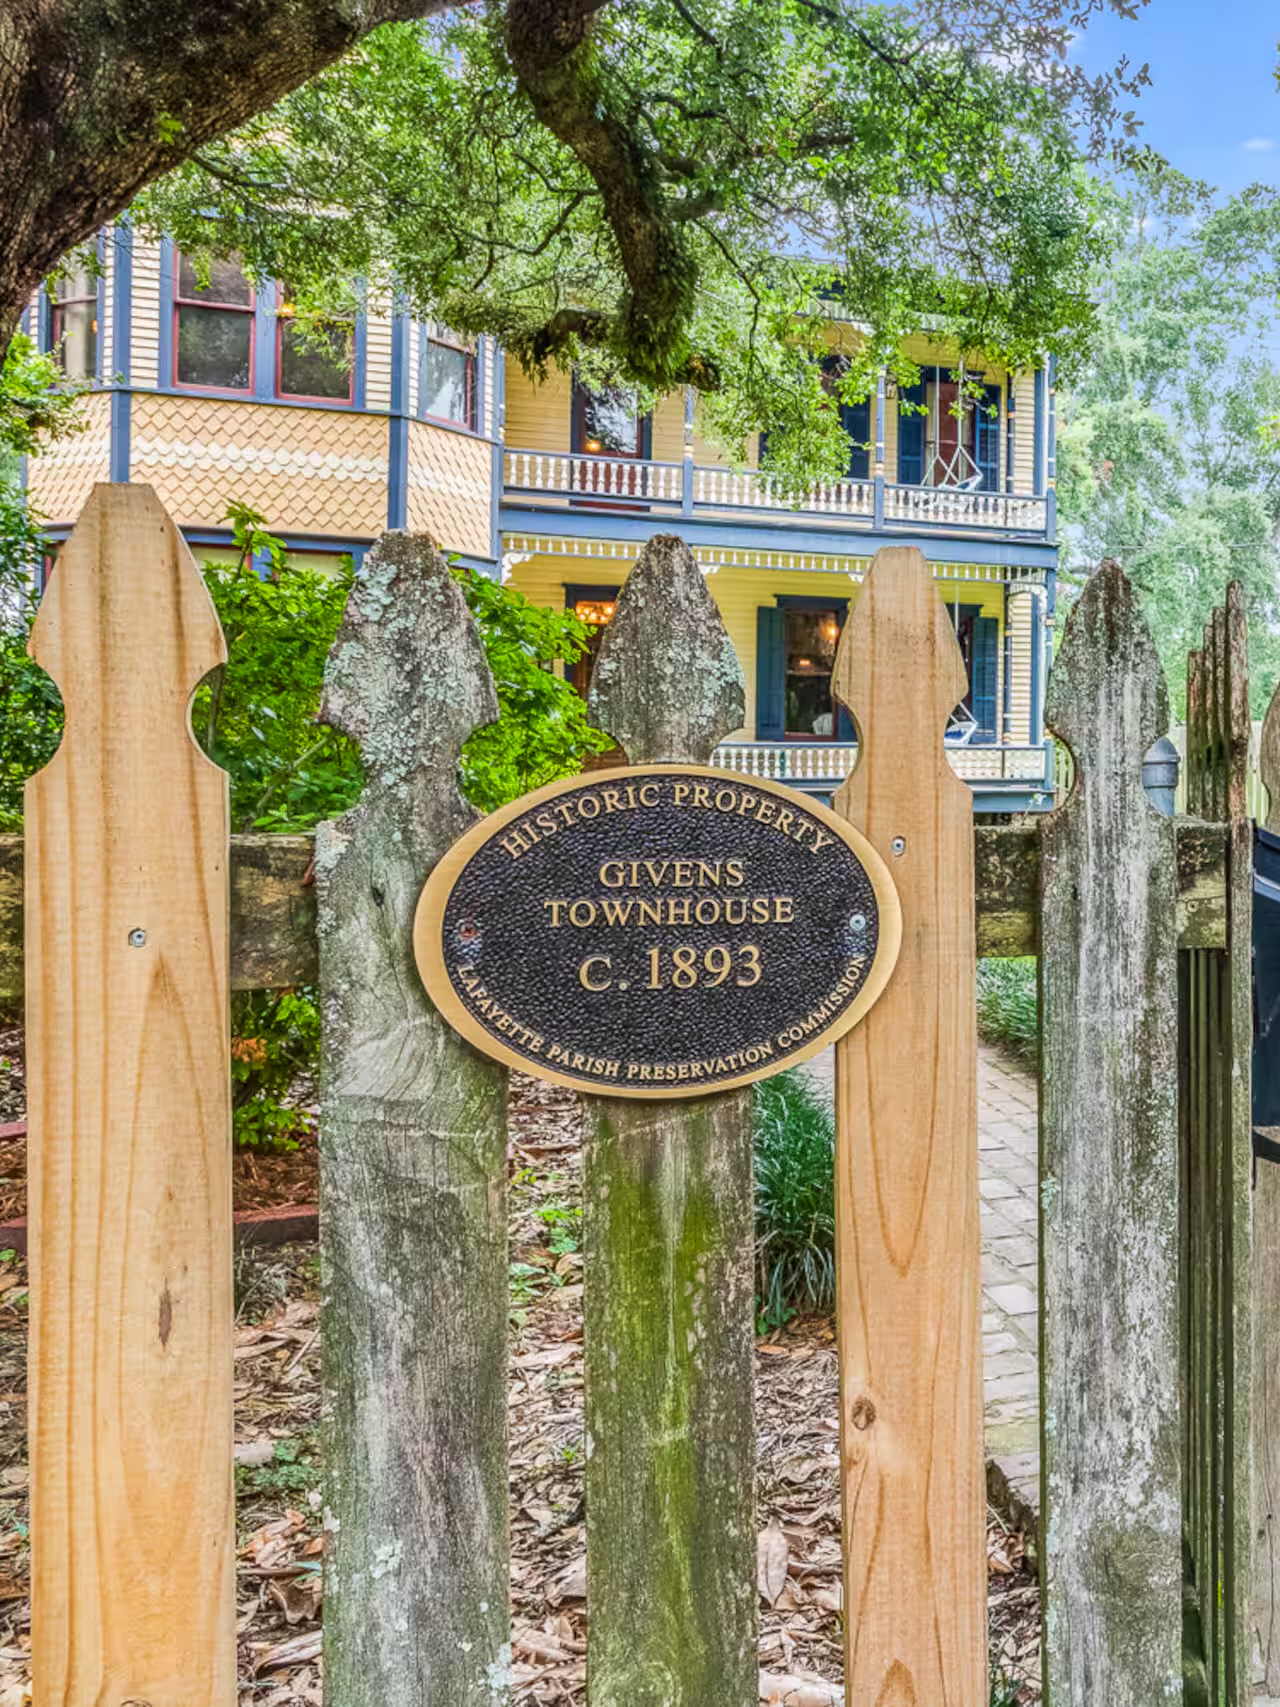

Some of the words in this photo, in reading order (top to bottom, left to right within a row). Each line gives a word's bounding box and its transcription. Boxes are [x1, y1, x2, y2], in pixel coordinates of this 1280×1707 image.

[500, 783, 661, 860] HISTORIC
[673, 784, 836, 857] PROPERTY
[599, 860, 746, 889] GIVENS
[543, 896, 796, 929] TOWNHOUSE
[645, 943, 763, 990] 1893
[457, 963, 545, 1052] LAFAYETTE
[546, 1045, 620, 1079] PARISH
[626, 1042, 773, 1080] PRESERVATION
[777, 953, 867, 1049] COMMISSION
